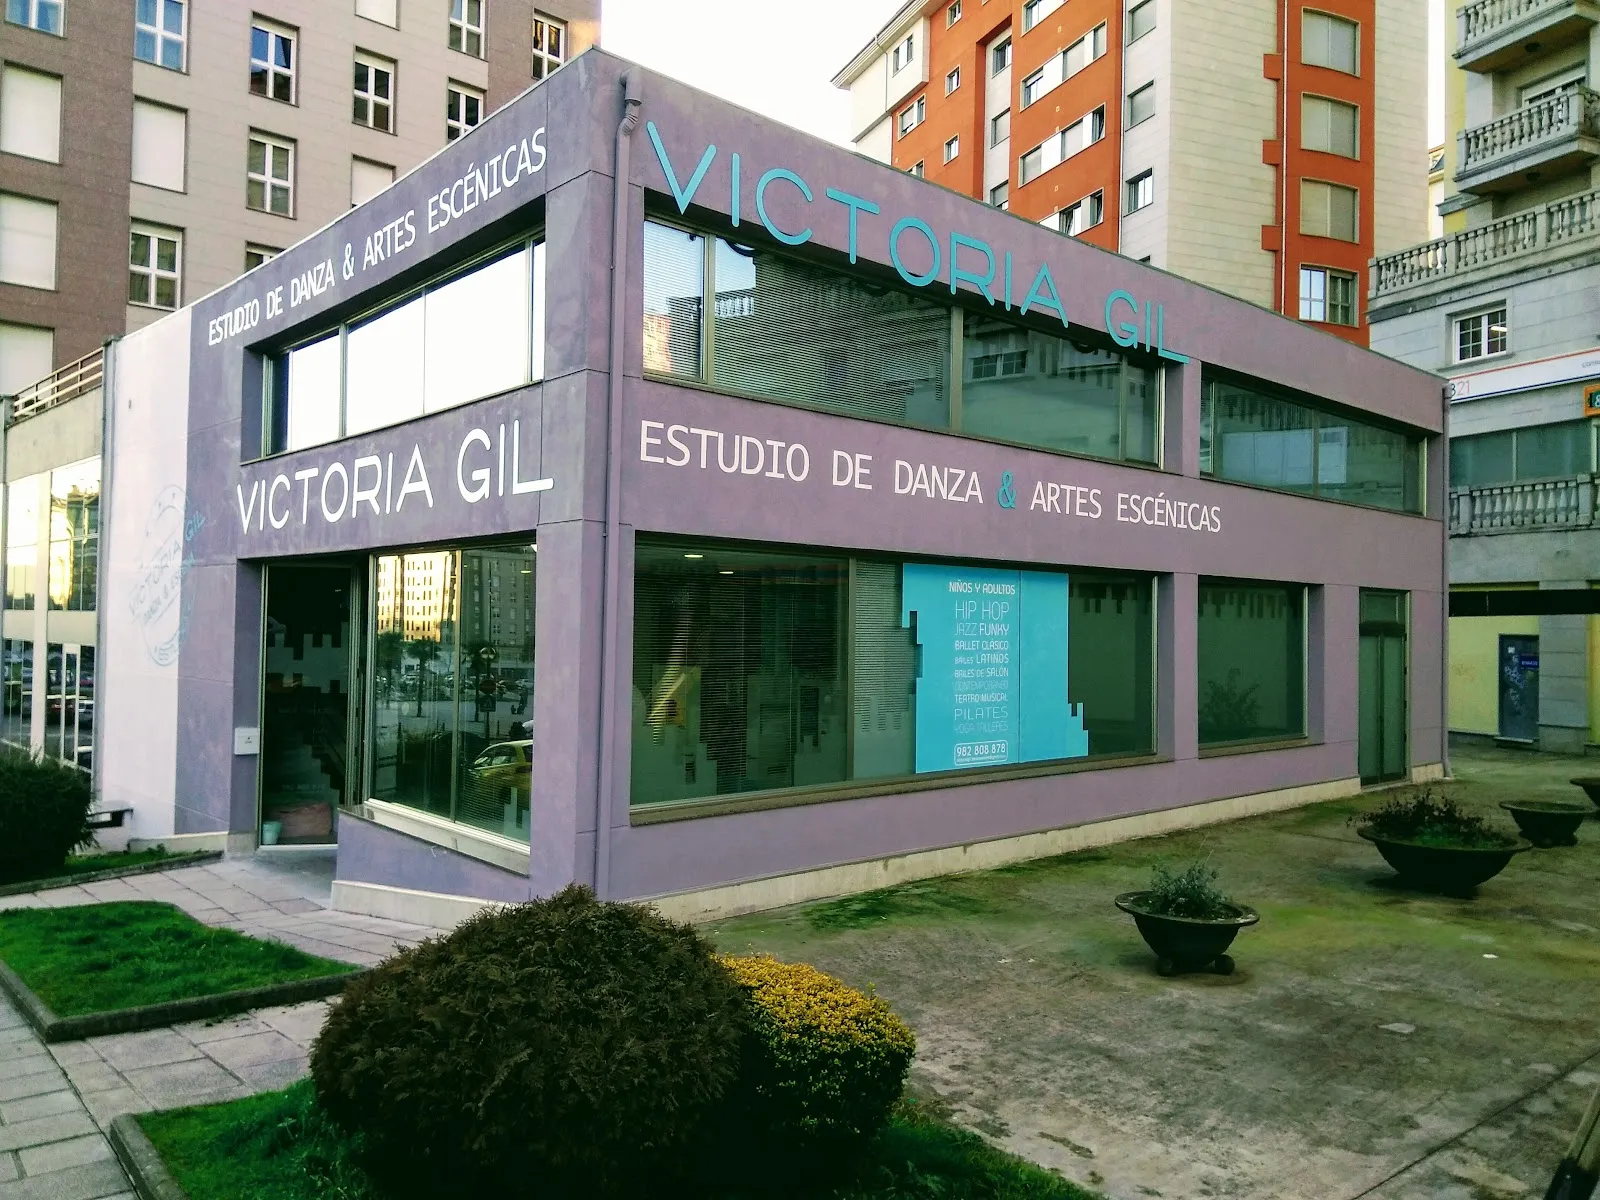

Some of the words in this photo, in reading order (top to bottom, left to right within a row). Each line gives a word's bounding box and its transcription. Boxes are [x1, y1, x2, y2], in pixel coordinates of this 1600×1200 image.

[207, 299, 260, 346] ESTUDIO
[265, 286, 284, 318] DE
[290, 258, 336, 308] DANZA
[342, 242, 355, 279] &
[363, 209, 416, 271] ARTES
[427, 127, 547, 234] ESCÉNICAS
[647, 122, 1069, 328] VICTORIA
[1105, 290, 1190, 364] GIL
[236, 442, 434, 536] VICTORIA
[457, 419, 554, 504] GIL
[640, 419, 810, 482] ESTUDIO
[833, 450, 873, 491] DE
[895, 460, 984, 504] DANZA
[997, 471, 1017, 510] &
[1029, 481, 1102, 519] ARTES
[1117, 491, 1221, 533] ESCÉNICAS
[949, 579, 973, 593] NIÑOS
[974, 583, 981, 593] Y
[982, 583, 1016, 595] ADULTOS
[955, 599, 977, 620] HIP
[981, 600, 1010, 621] HOP
[954, 622, 977, 636] JAZZ
[979, 623, 1010, 636] FUNKY
[954, 640, 980, 650] BALLET
[981, 638, 1009, 650] CLÁSICO
[954, 656, 974, 665] BAILES
[976, 653, 1010, 664] LATINOS
[954, 669, 975, 678] BAILES
[976, 668, 985, 678] DE
[986, 664, 1009, 677] SALÓN
[954, 694, 980, 704] TEATRO
[981, 692, 1009, 702] MUSICAL
[954, 706, 1009, 721] PILATES
[956, 746, 972, 757] 982
[974, 744, 989, 756] 808
[991, 743, 1006, 754] 878
